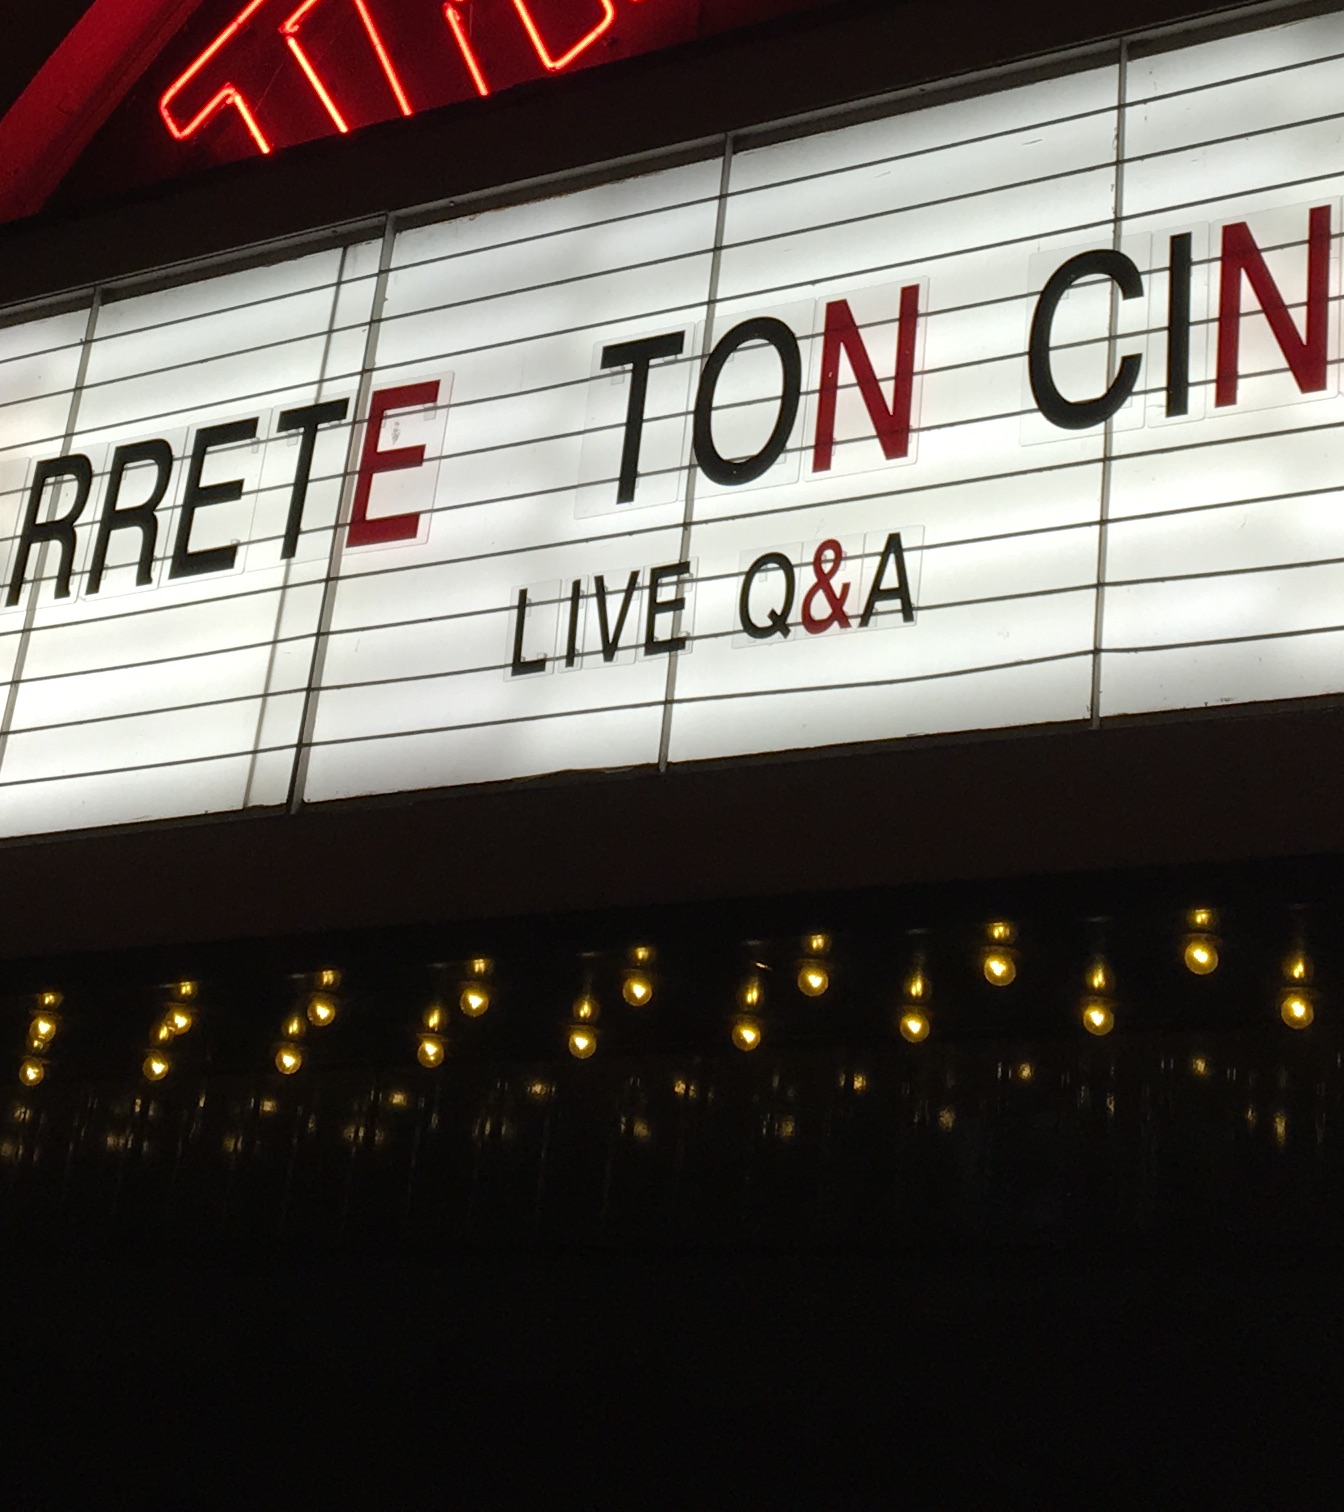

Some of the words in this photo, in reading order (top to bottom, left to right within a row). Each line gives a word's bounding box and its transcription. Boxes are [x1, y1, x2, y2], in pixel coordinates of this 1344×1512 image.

[600, 284, 920, 504] TON
[510, 560, 690, 676] LIVE
[740, 532, 915, 640] Q&A
